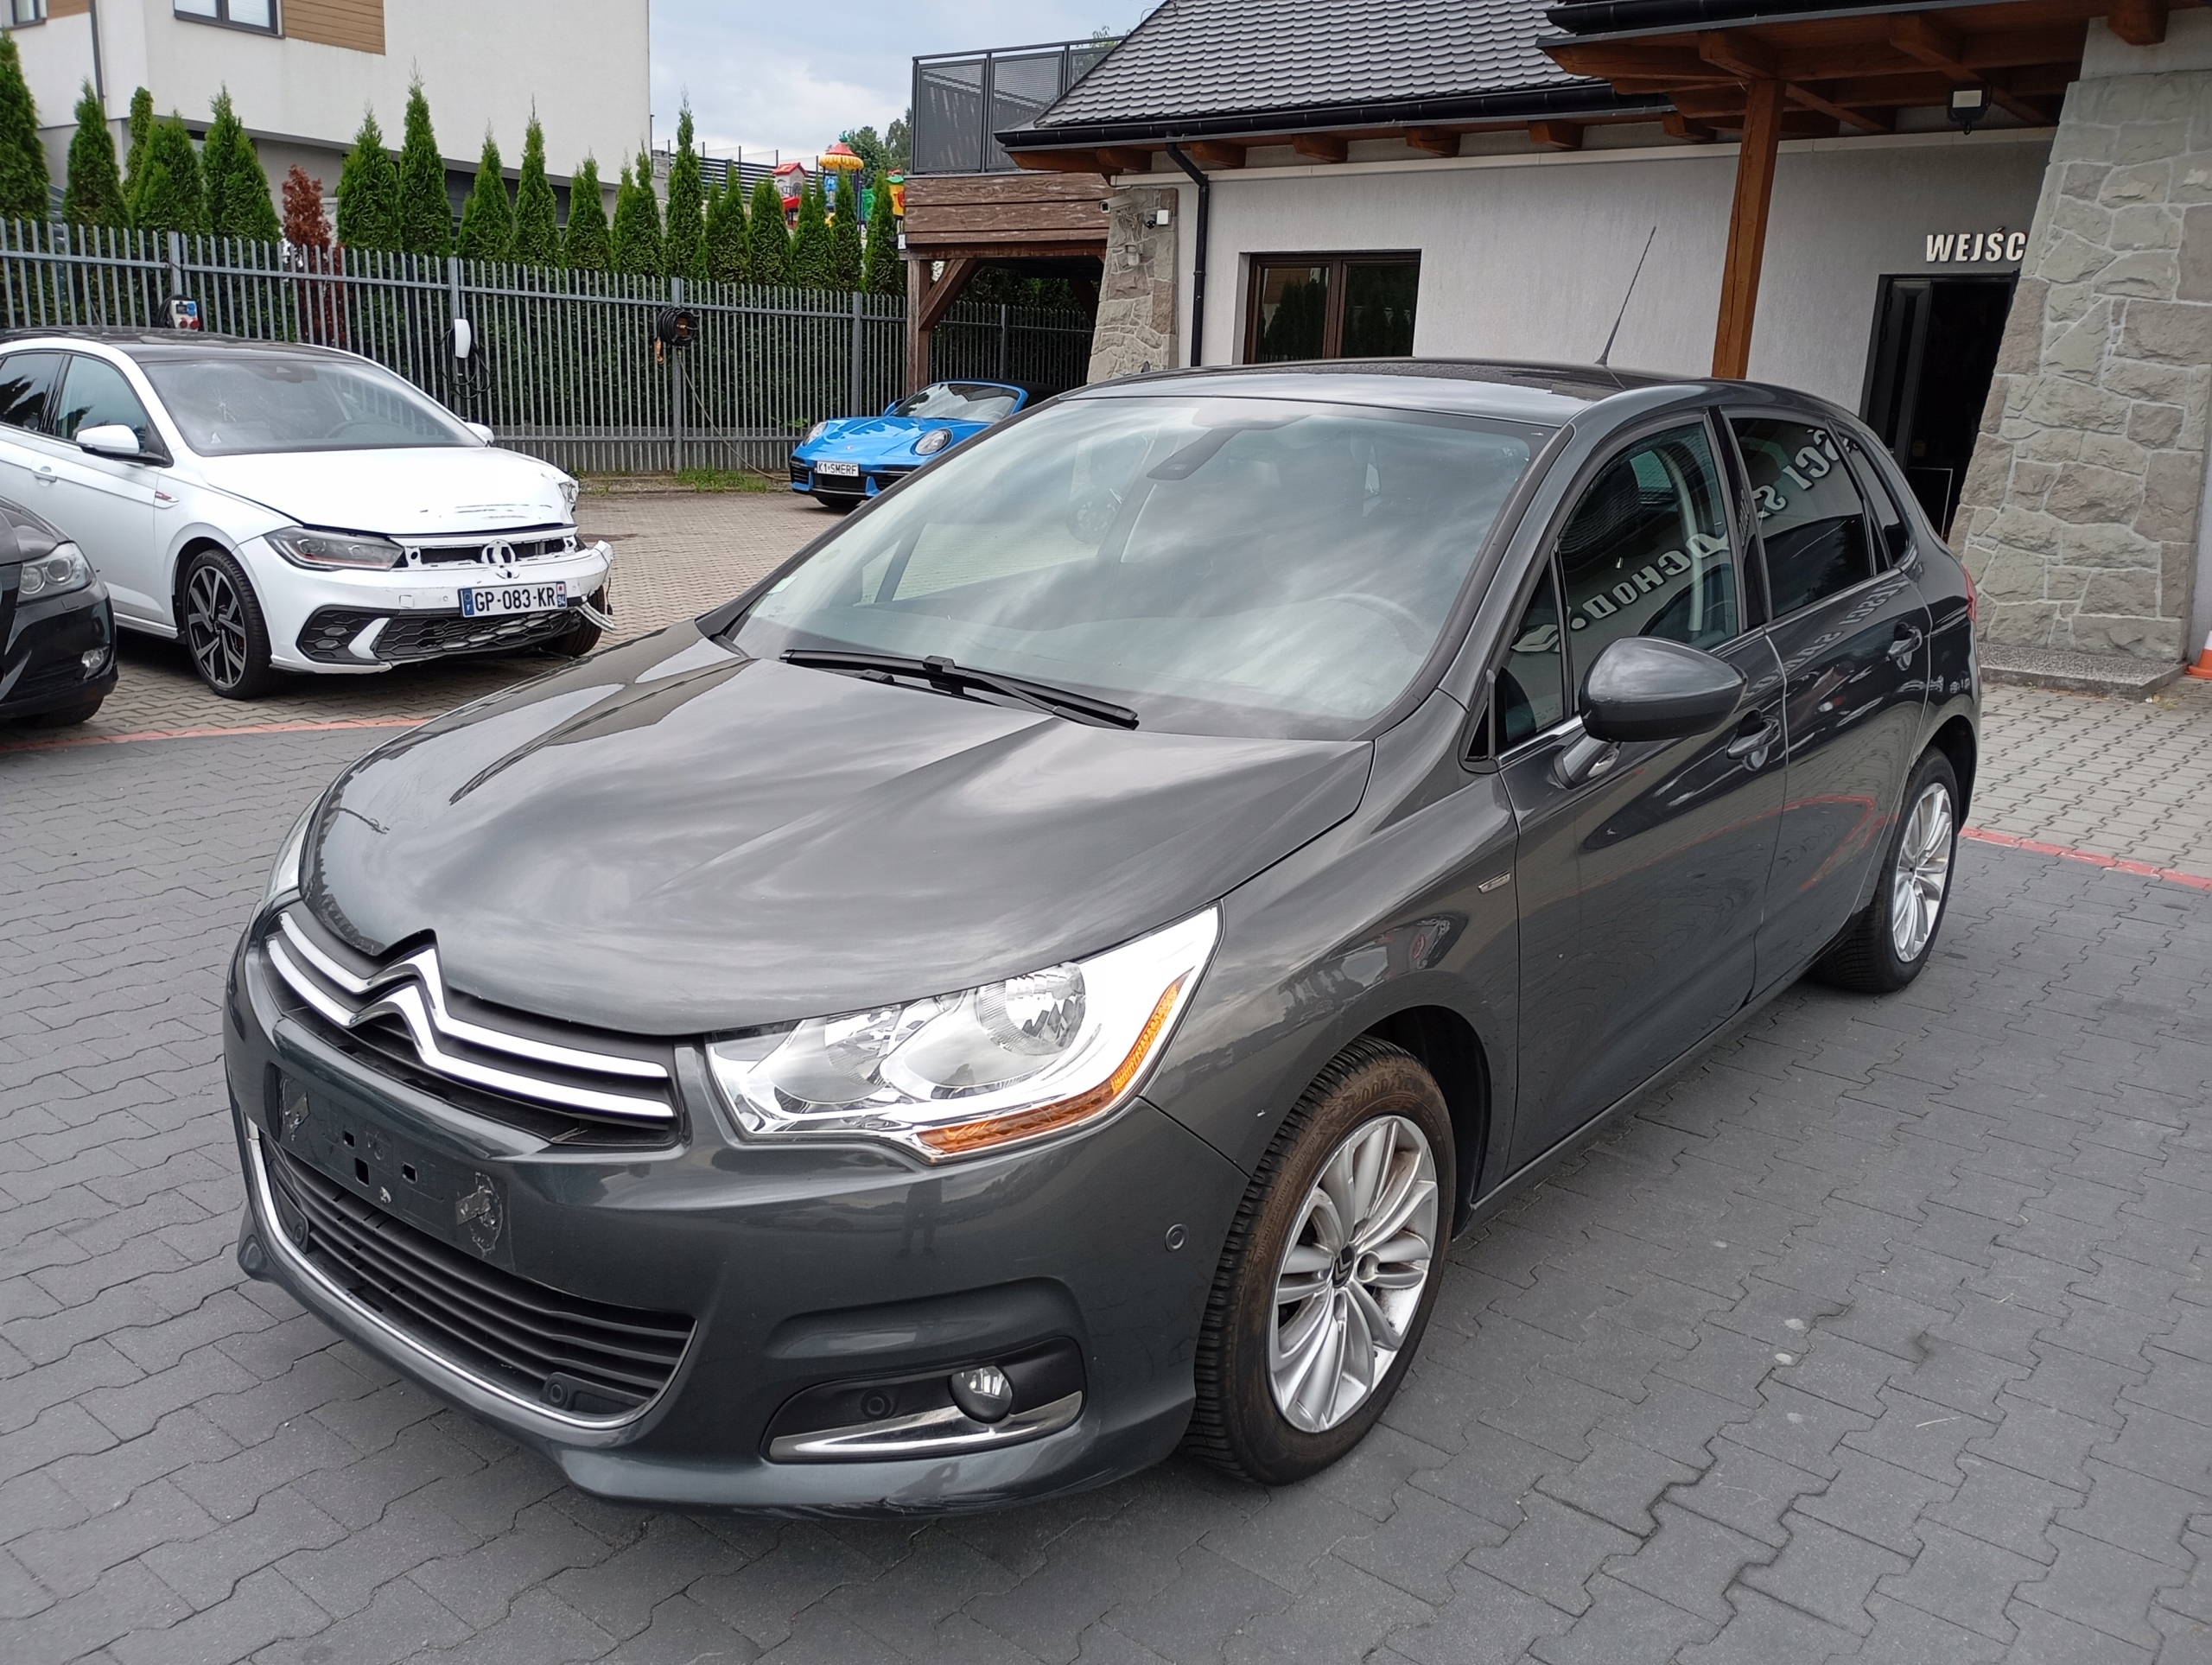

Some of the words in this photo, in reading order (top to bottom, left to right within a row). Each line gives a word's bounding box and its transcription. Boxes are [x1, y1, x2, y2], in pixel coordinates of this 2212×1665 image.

[830, 463, 857, 475] SMERF
[474, 587, 556, 612] GP-083-KR
[557, 596, 566, 606] 94
